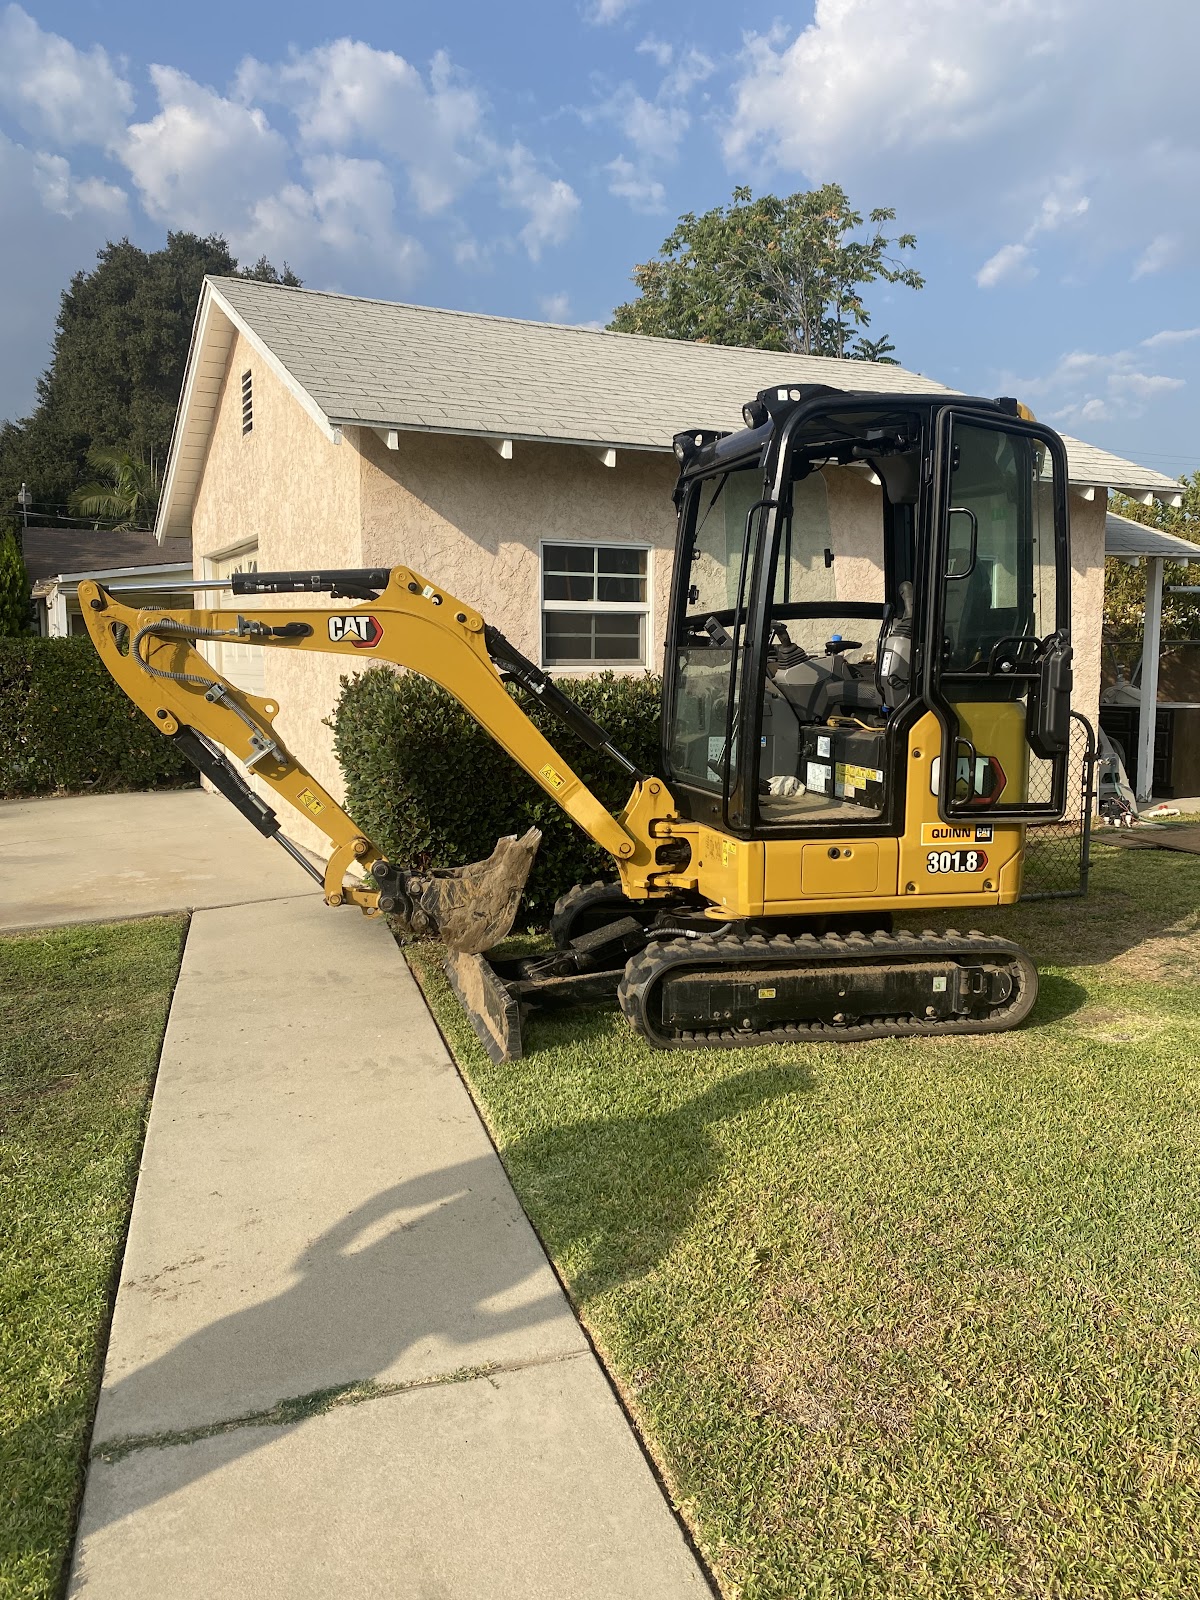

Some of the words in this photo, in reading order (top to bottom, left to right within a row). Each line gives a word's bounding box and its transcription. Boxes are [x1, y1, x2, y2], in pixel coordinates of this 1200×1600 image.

[328, 616, 370, 642] CAT
[931, 828, 971, 839] QUINN
[976, 827, 992, 838] CAT
[927, 851, 979, 873] 301.8
